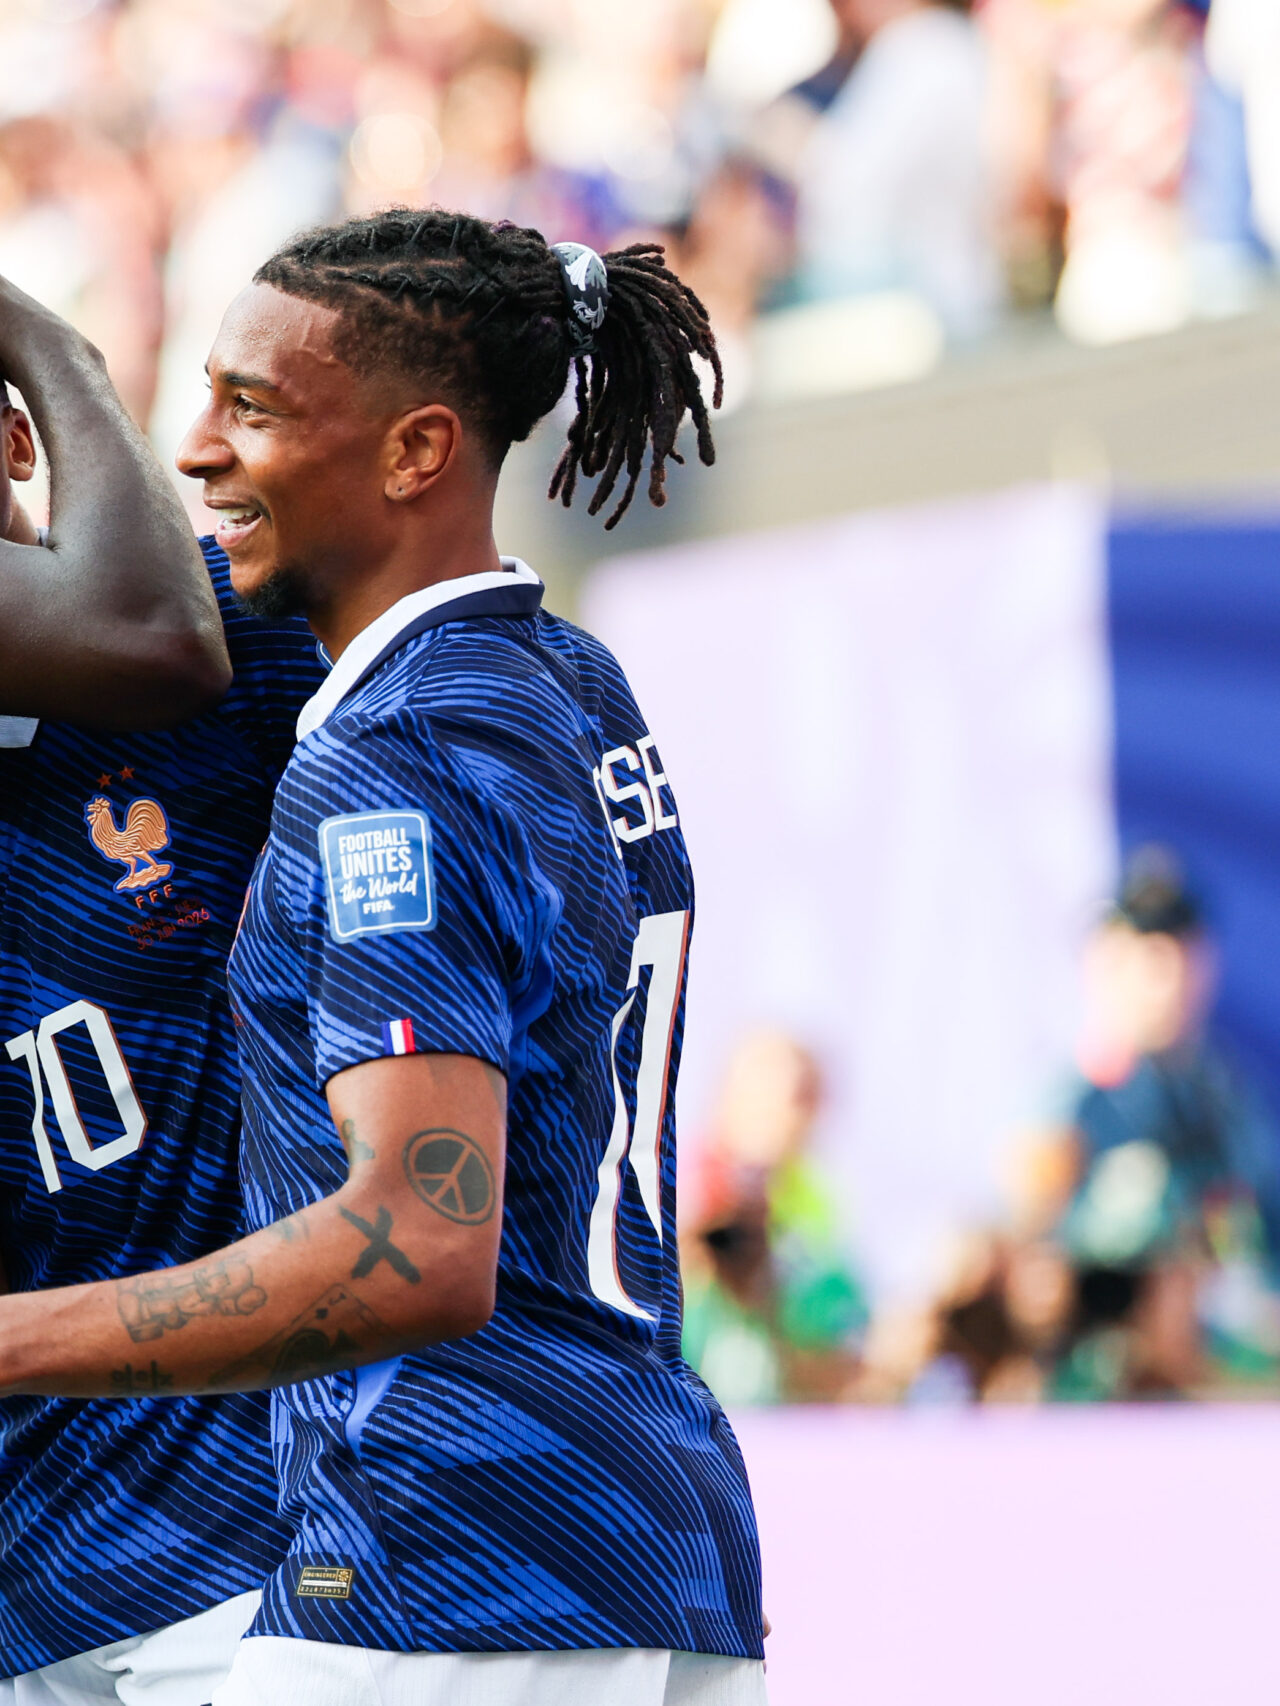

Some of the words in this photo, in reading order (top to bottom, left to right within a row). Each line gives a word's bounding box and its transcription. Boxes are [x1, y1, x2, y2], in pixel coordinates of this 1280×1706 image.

[338, 827, 410, 855] FOOTBALL
[340, 846, 413, 880] UNITES
[339, 878, 367, 905] the
[368, 871, 419, 899] World
[176, 907, 211, 928] 2026
[362, 899, 394, 915] FIFA
[4, 998, 149, 1195] 10
